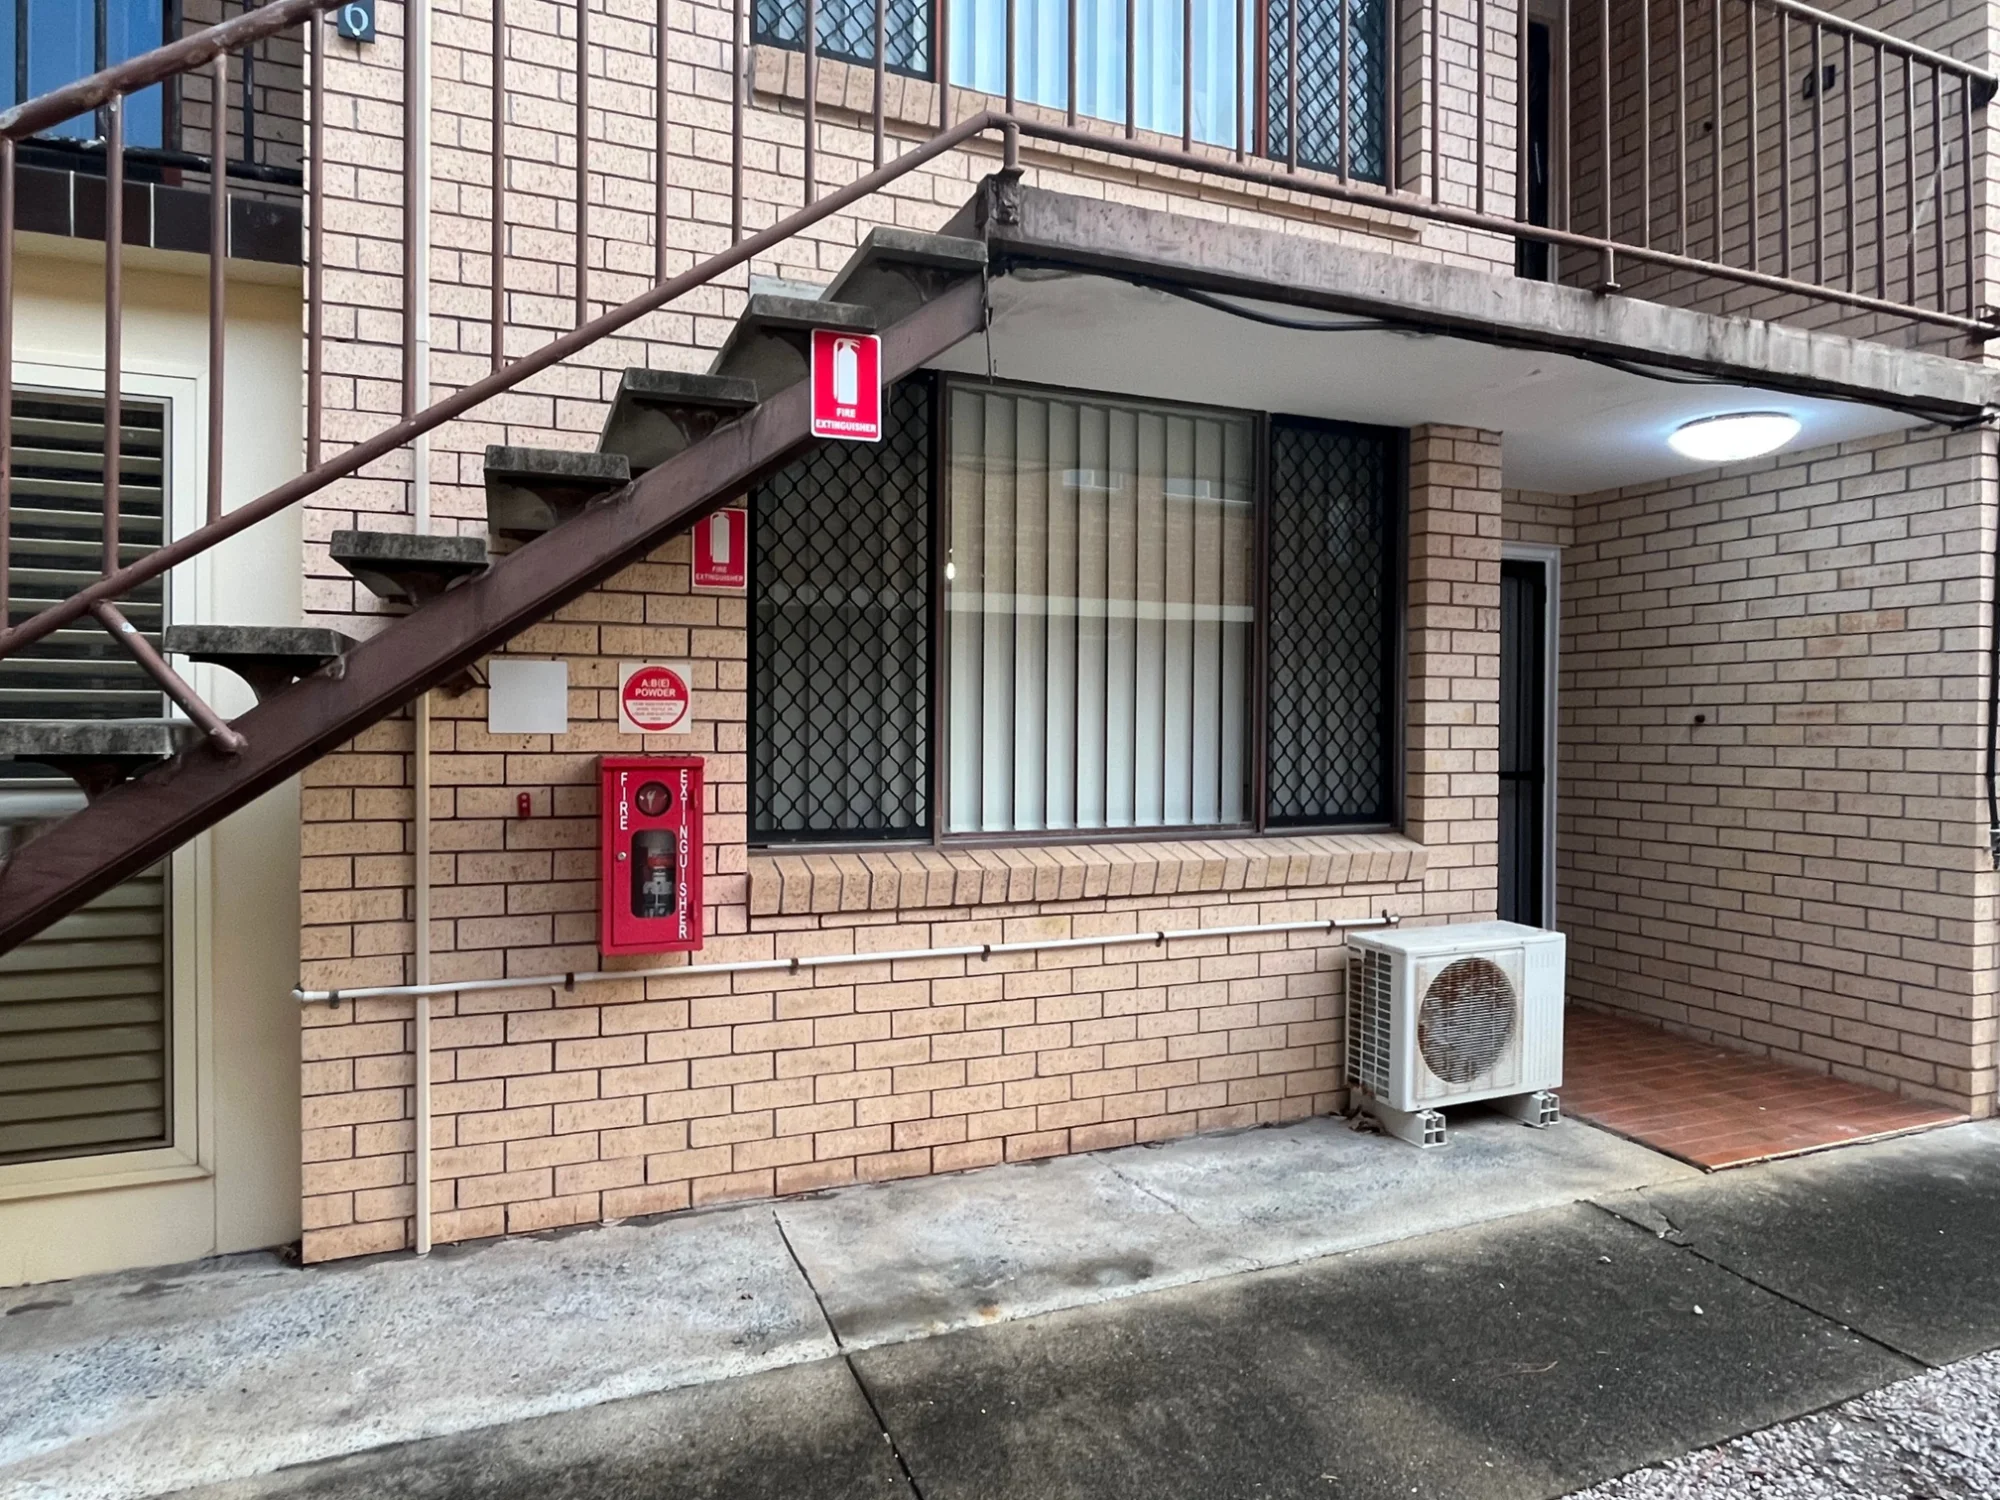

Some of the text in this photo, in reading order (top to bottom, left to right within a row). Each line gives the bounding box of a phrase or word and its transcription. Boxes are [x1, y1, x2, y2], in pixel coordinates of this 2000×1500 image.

[836, 407, 856, 419] FIRE
[815, 418, 877, 433] EXTINGUISHER
[712, 565, 728, 574] FIRE
[635, 687, 676, 697] POWDER
[619, 772, 628, 830] FIRE
[678, 769, 688, 939] EXTINGUISHER
